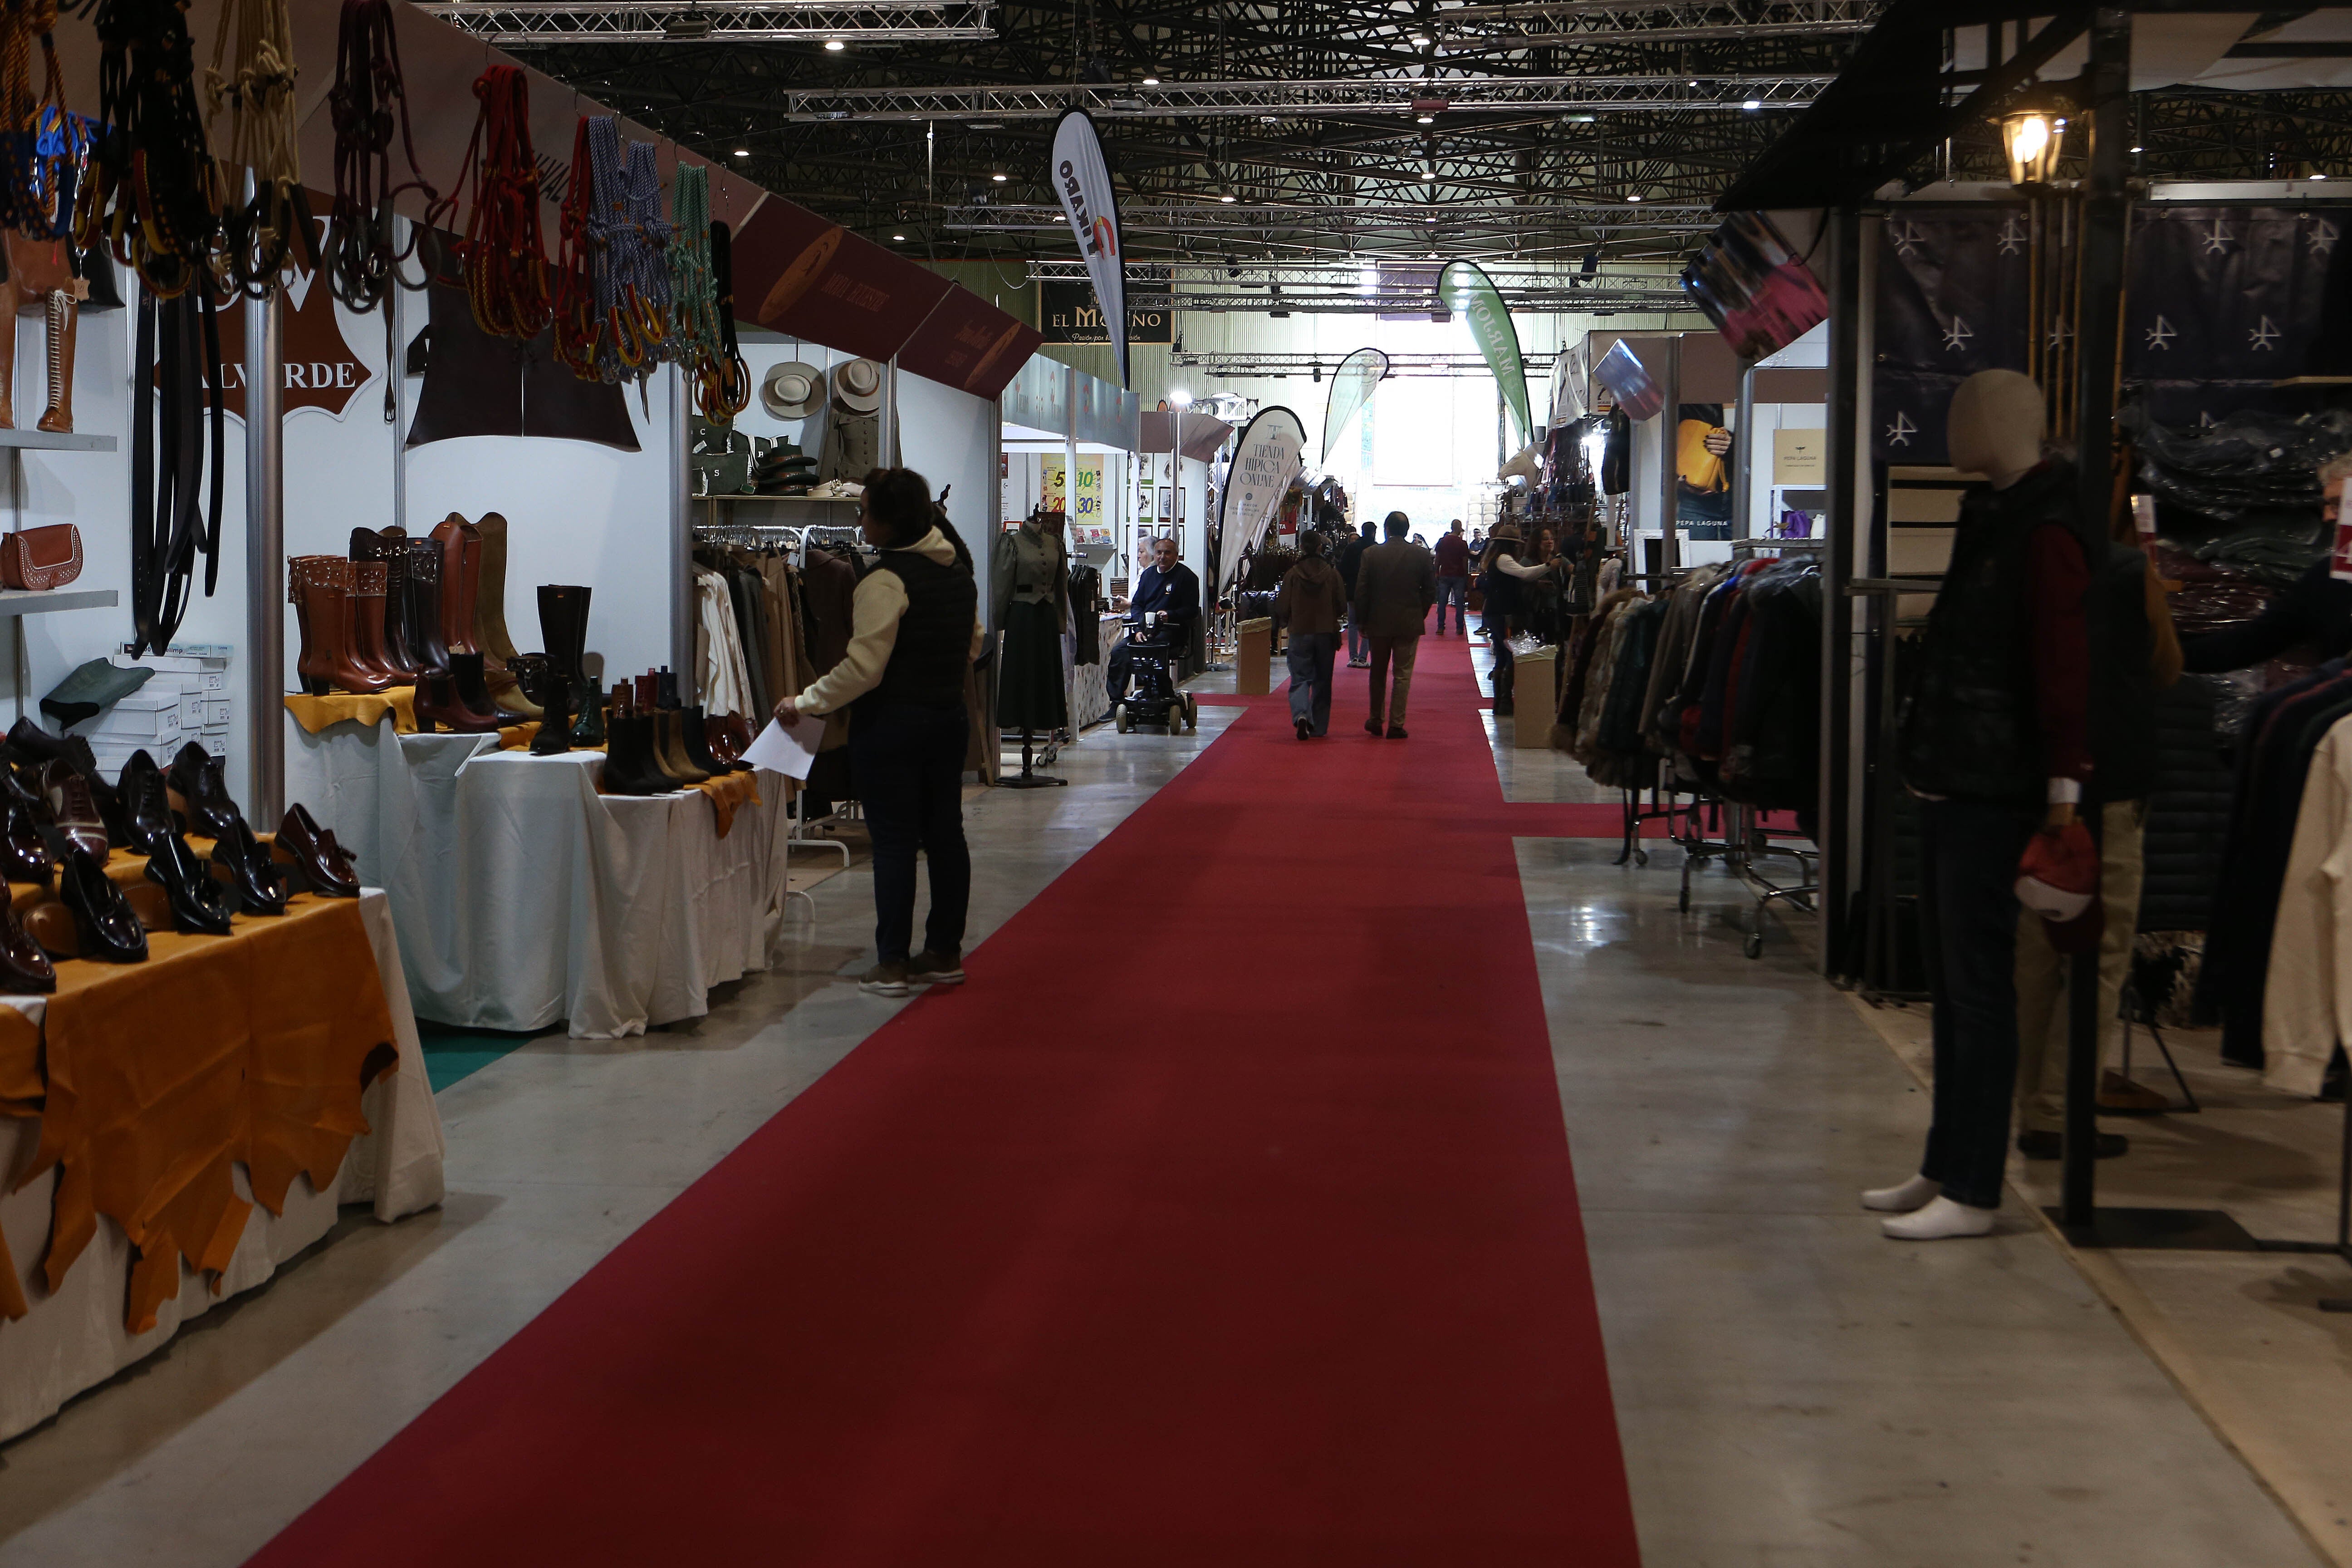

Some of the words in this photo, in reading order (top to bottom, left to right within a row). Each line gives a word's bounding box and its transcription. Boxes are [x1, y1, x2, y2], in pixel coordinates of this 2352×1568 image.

[1052, 314, 1069, 327] EL
[1254, 444, 1284, 460] TIENDA
[1245, 457, 1279, 474] HÍPICA
[1054, 471, 1065, 487] 5
[1078, 471, 1093, 487] 10
[1240, 472, 1274, 488] ONLINE
[1051, 497, 1065, 513] 20
[1078, 497, 1093, 514] 30
